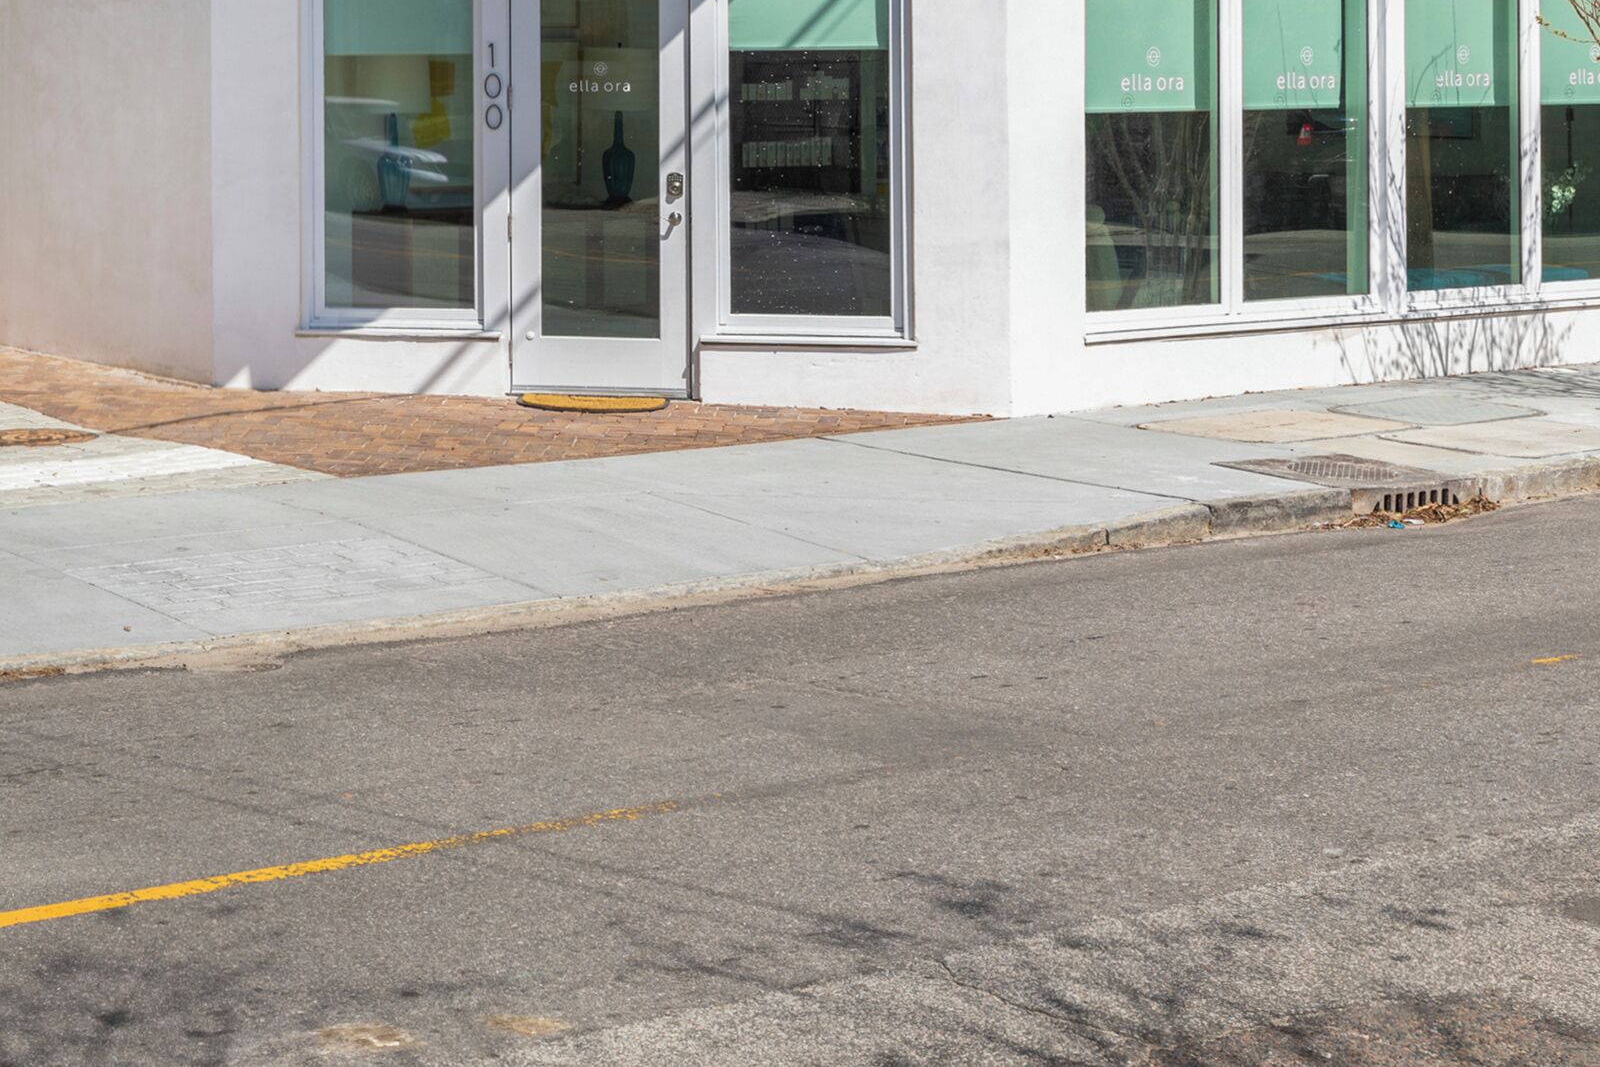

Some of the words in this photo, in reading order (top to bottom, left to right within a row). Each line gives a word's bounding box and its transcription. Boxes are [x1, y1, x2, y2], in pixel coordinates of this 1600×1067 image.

[1121, 73, 1151, 91] ella
[1156, 76, 1185, 91] ora
[1276, 72, 1305, 90] ella
[1309, 75, 1336, 90] ora
[1436, 70, 1463, 87] ella
[1466, 72, 1491, 87] ora
[1569, 68, 1594, 85] ella
[484, 43, 503, 130] 100
[568, 79, 599, 93] ella
[603, 81, 631, 93] ora
